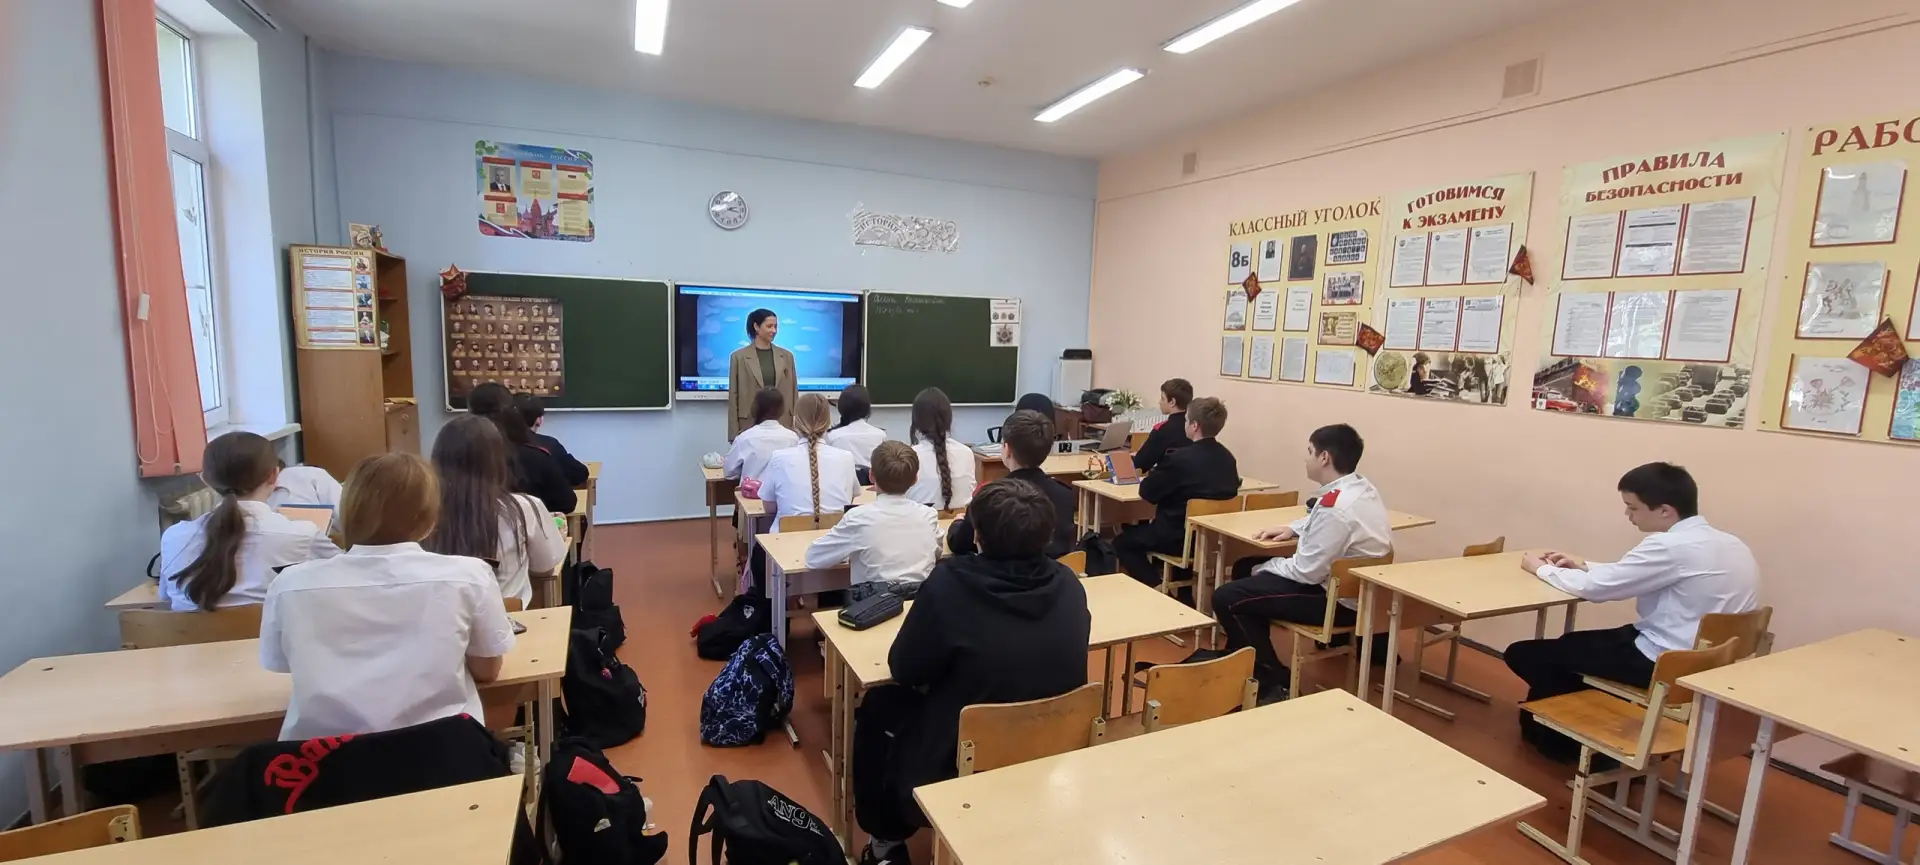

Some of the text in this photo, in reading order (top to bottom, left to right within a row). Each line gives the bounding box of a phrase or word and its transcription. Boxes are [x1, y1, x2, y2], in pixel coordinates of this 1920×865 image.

[1602, 152, 1726, 183] ПРАВИЛА
[1407, 185, 1505, 214] ГОТОВИМСЯ
[1585, 172, 1743, 202] БЕЗОПАСНОСТИ
[1229, 199, 1381, 237] КЛАССНЫЙ УГОЛОК
[1402, 205, 1506, 230] К ЭКЗАМЕНУ
[1231, 251, 1249, 268] 8Б
